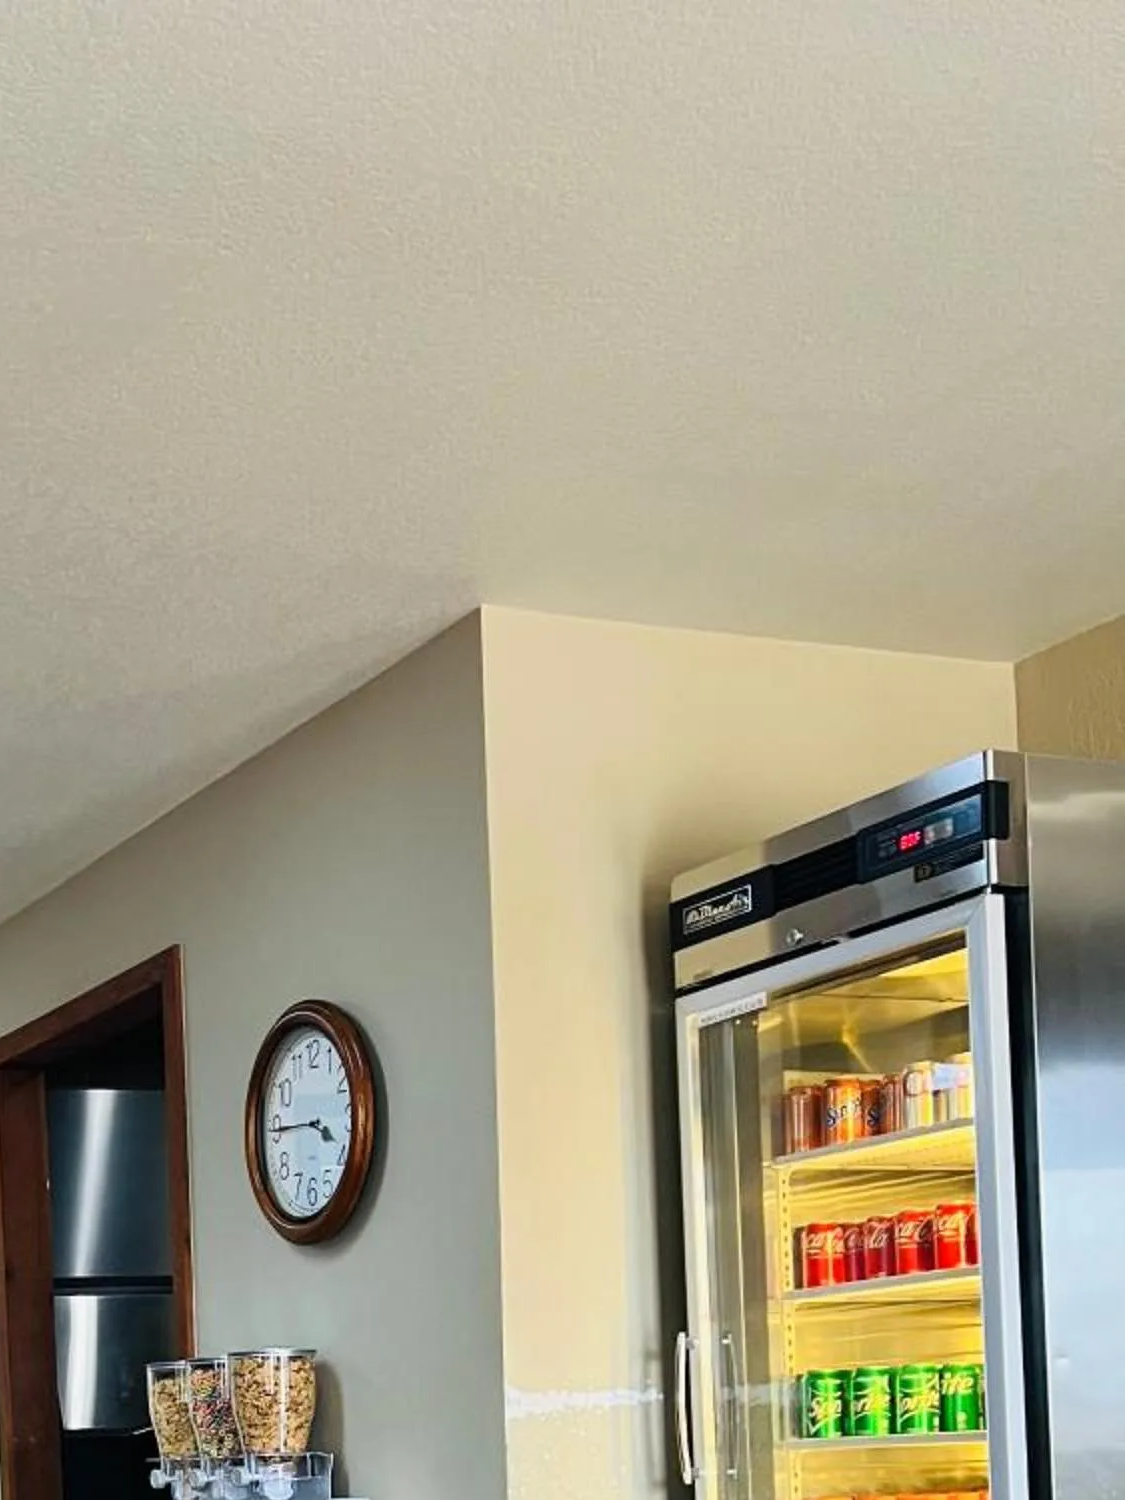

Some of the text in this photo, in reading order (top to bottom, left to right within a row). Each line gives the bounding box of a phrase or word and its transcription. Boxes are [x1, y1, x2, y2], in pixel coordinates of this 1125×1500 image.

[291, 1054, 304, 1080] 11
[306, 1039, 320, 1068] 12
[276, 1078, 292, 1107] 10
[272, 1114, 282, 1144] 9
[279, 1151, 290, 1180] 8
[293, 1172, 304, 1201] 7
[306, 1177, 318, 1207] 6
[322, 1169, 334, 1199] 5
